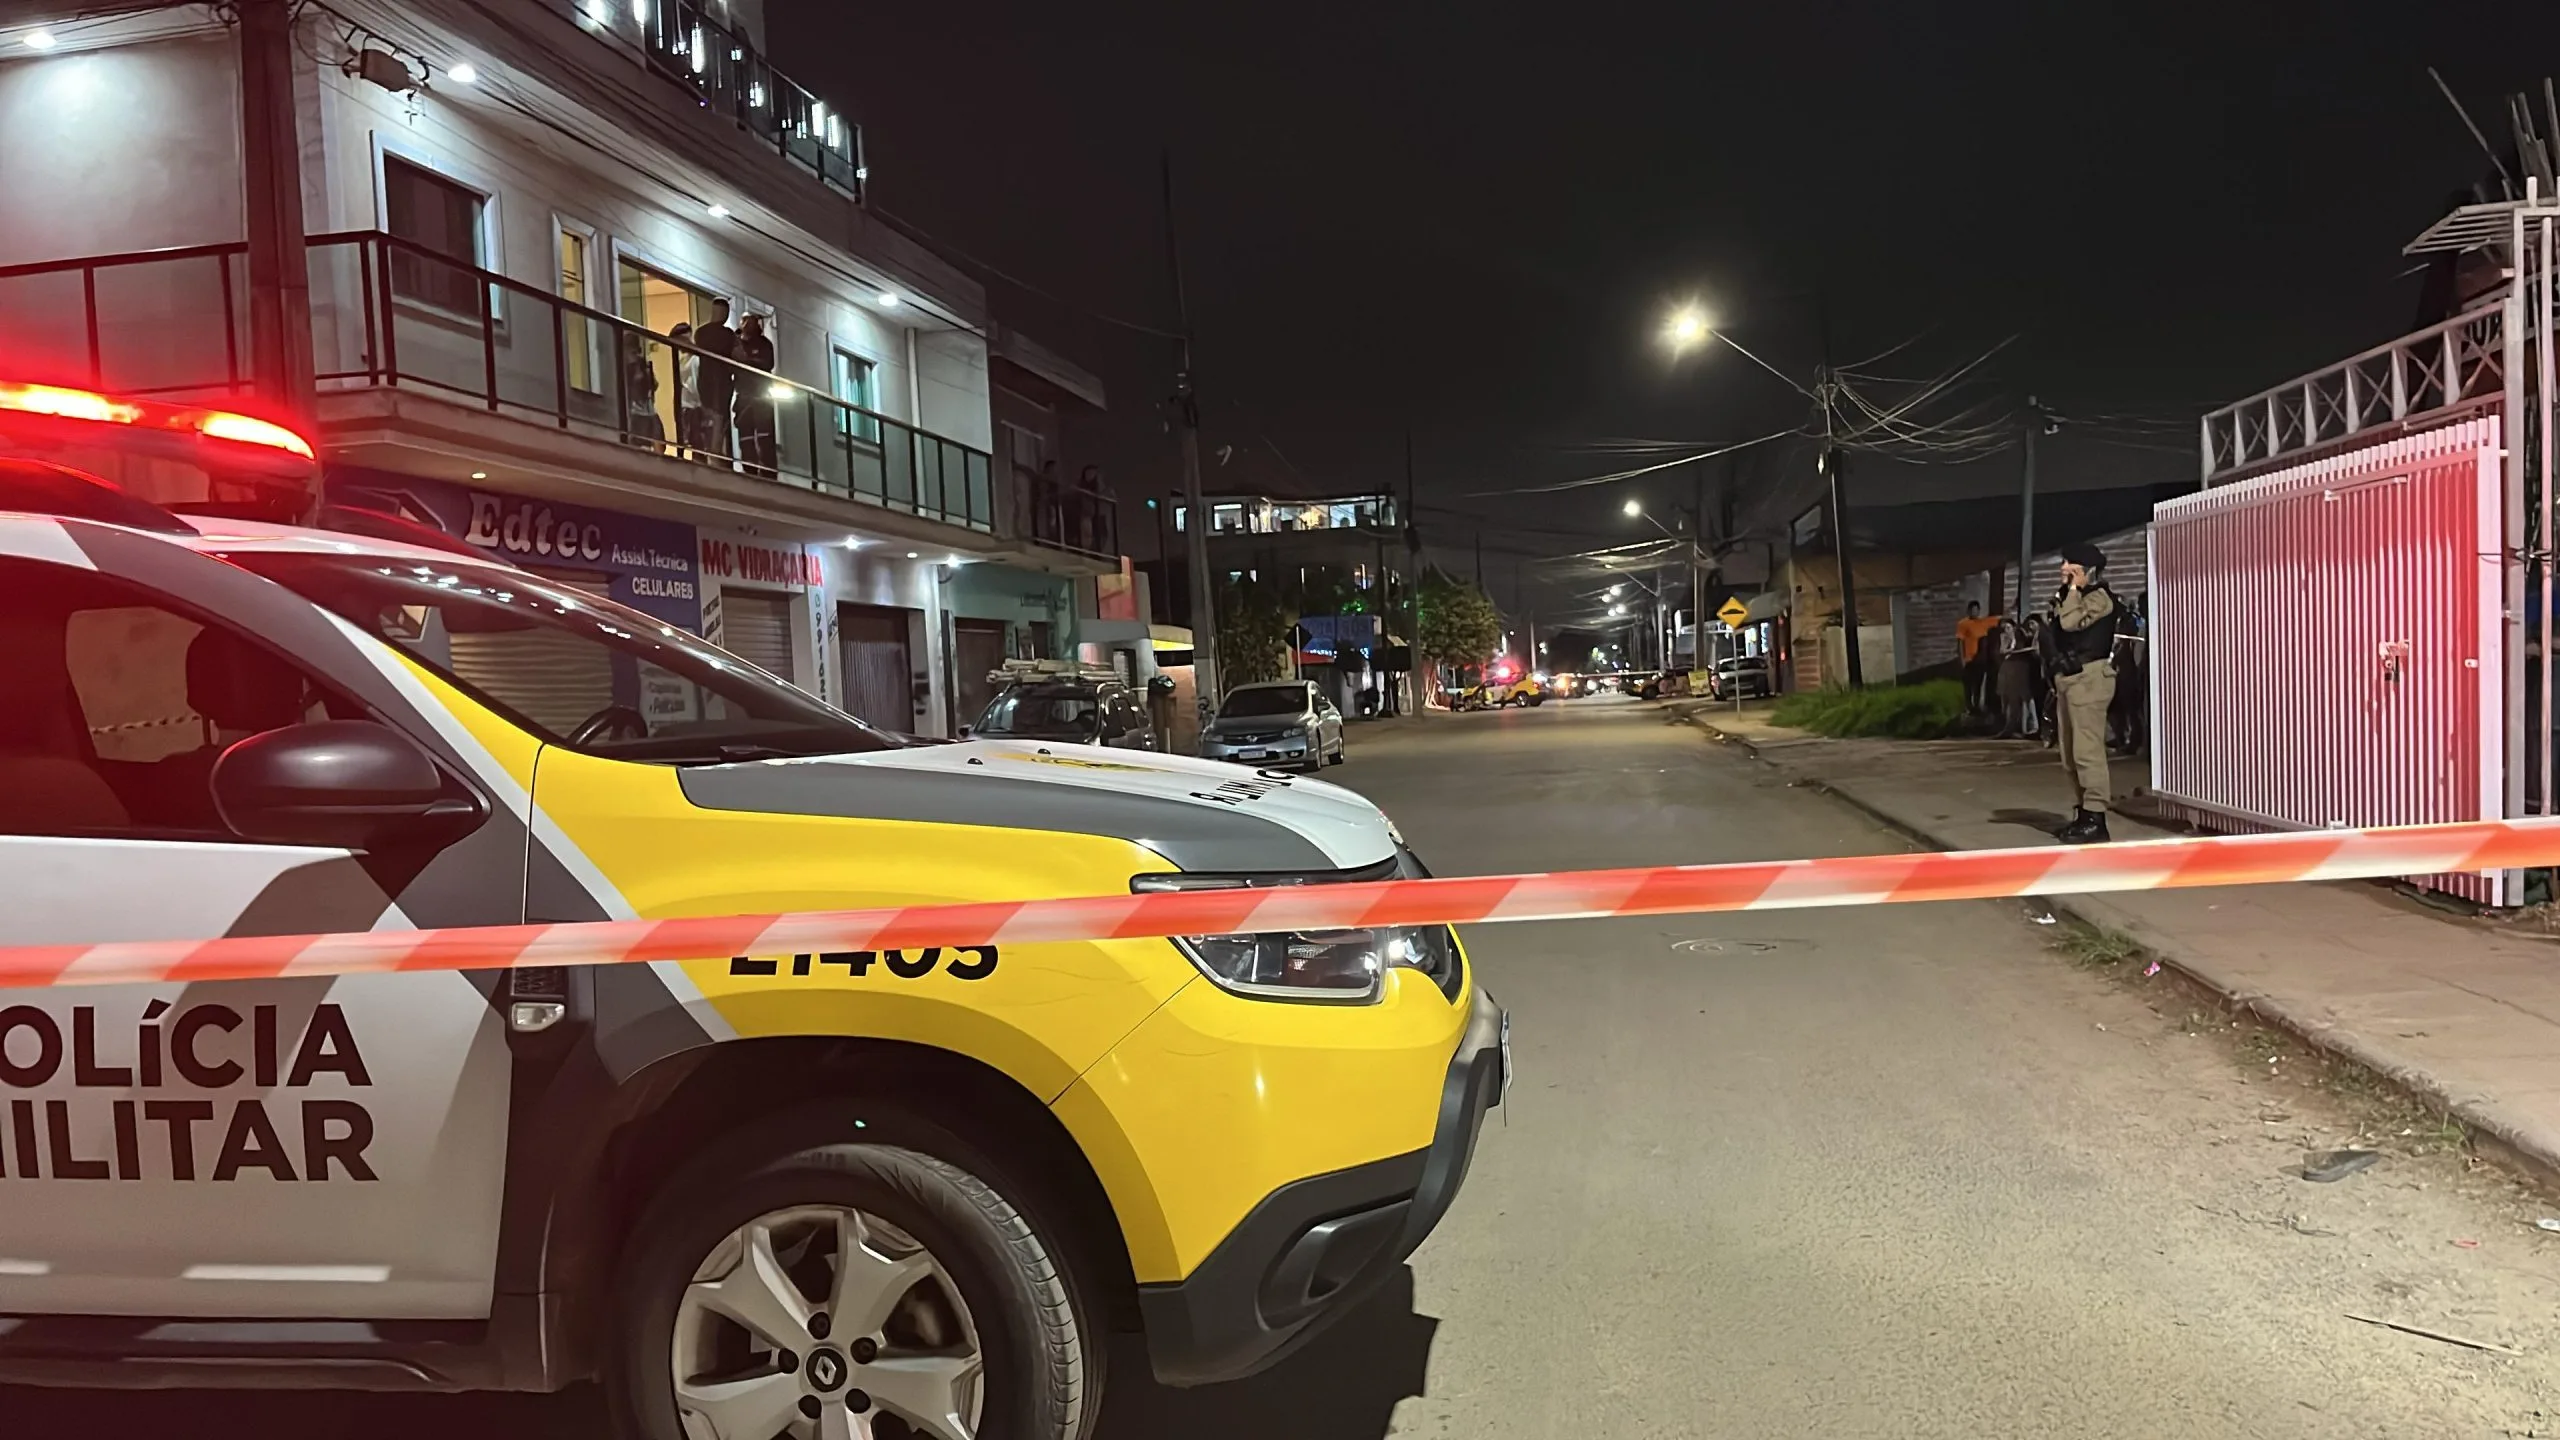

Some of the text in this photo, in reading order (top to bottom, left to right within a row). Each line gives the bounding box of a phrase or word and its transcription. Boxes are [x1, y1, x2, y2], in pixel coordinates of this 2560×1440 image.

[465, 492, 602, 560] Edtec
[632, 576, 694, 600] CELULARES
[702, 539, 823, 589] MC VIDRAÇARIA
[0, 1099, 379, 1181] ILITAR
